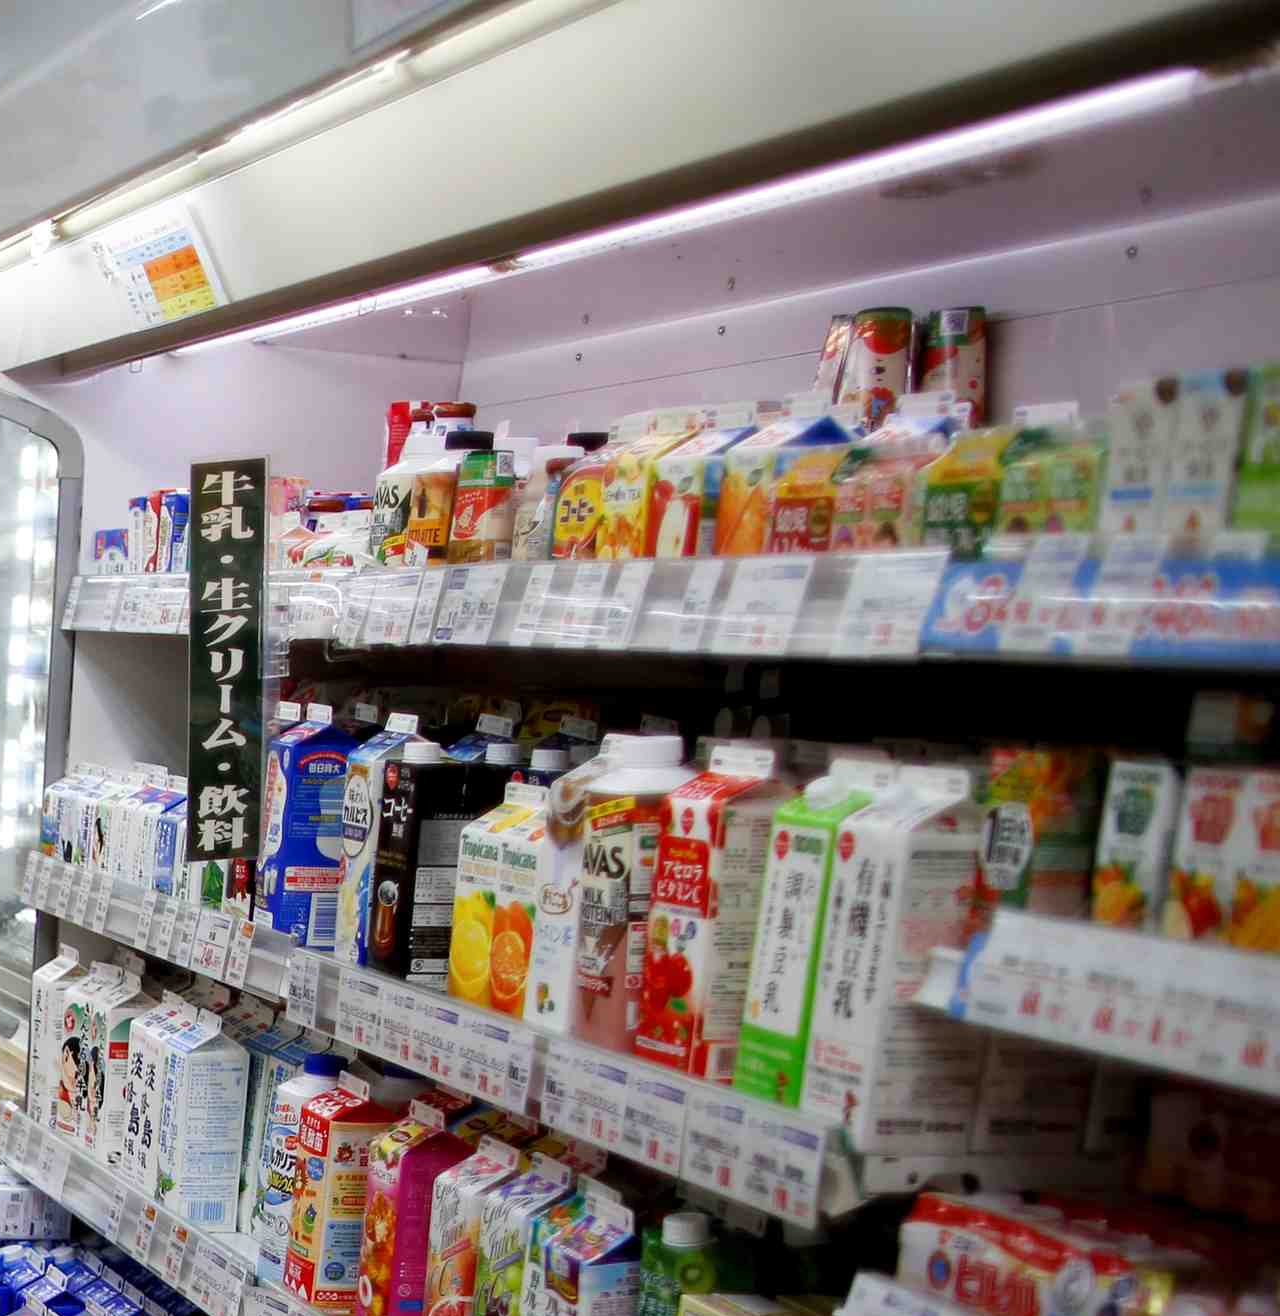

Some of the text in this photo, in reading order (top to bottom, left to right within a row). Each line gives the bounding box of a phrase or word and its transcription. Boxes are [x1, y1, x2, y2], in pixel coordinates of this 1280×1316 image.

[198, 470, 254, 852] 牛乳・生クリーム・飲料
[662, 860, 704, 881] アセロラ
